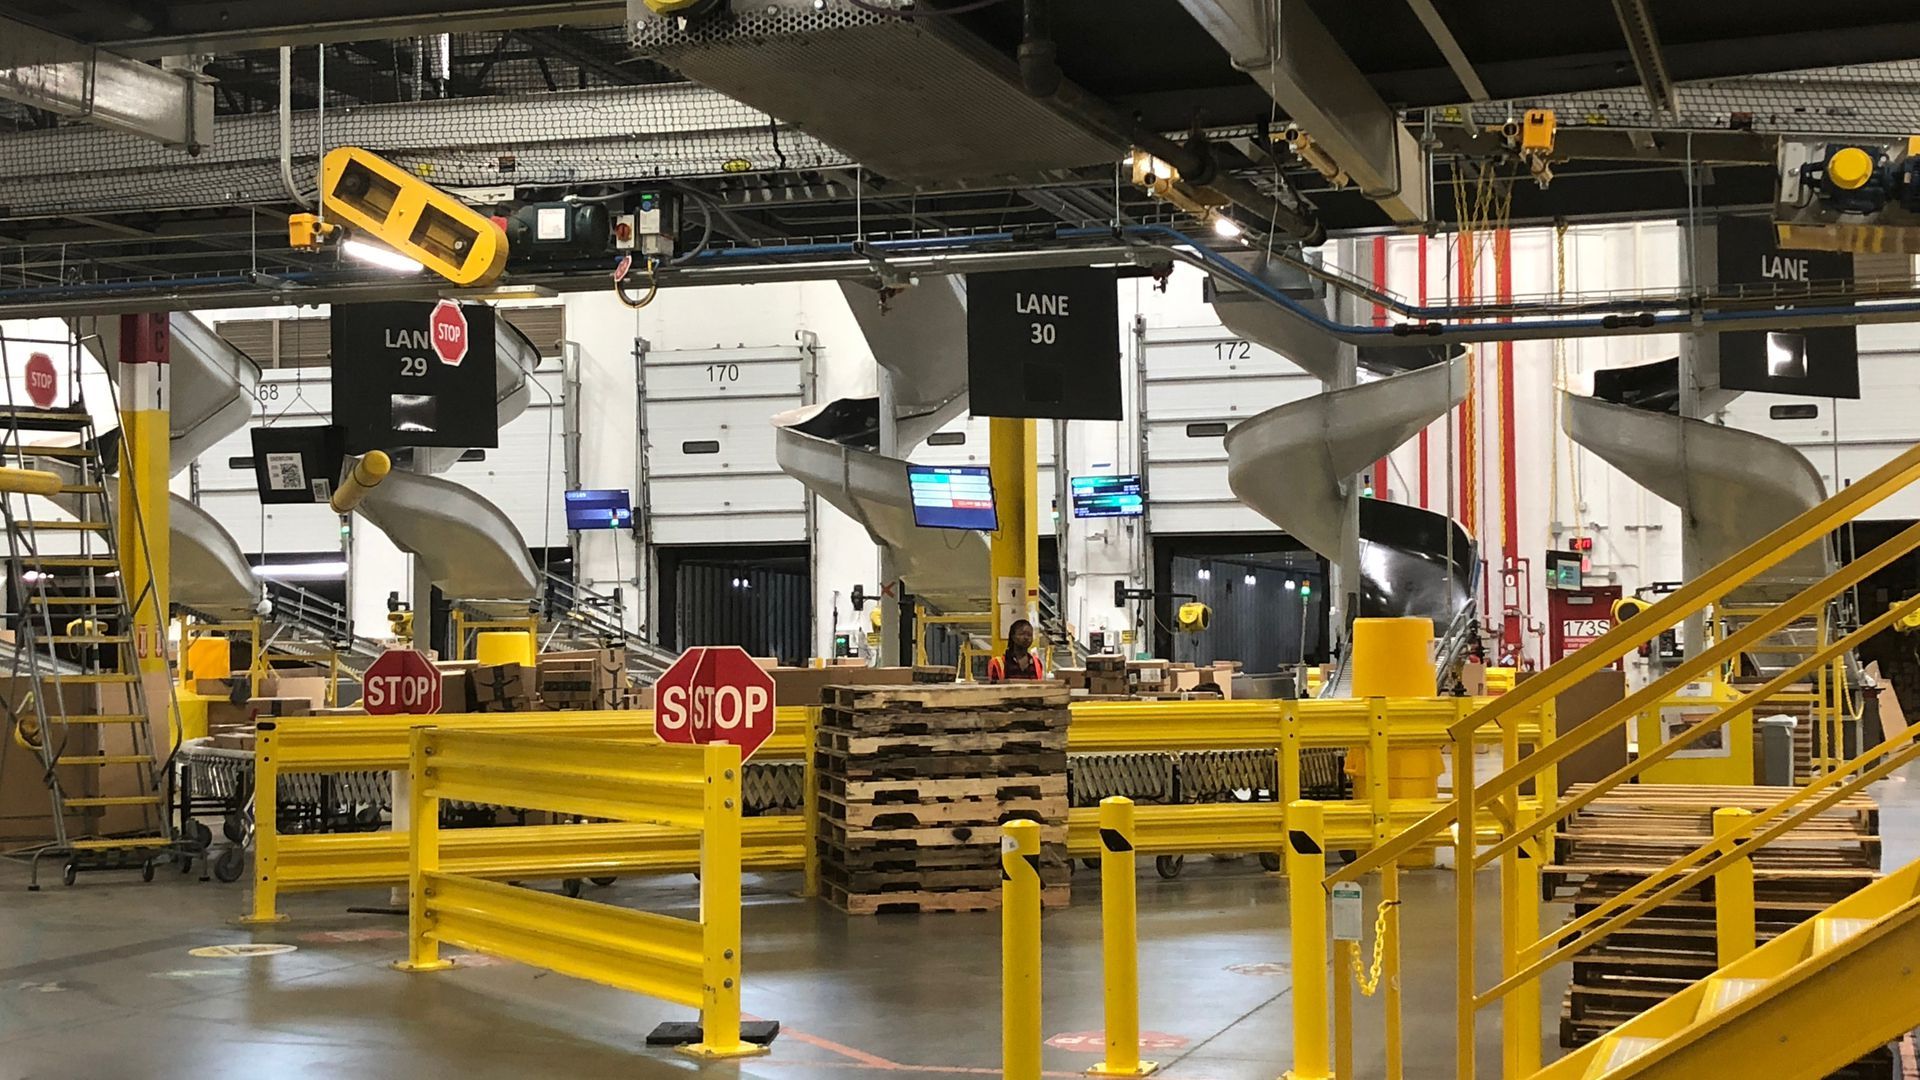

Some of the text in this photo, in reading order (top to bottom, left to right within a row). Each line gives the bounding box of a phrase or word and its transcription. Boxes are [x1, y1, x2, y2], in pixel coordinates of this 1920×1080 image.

[1761, 254, 1809, 281] LANE
[1016, 292, 1070, 317] LANE
[385, 328, 434, 351] LAN
[438, 322, 461, 344] STOP
[1030, 322, 1056, 345] 30
[1214, 340, 1251, 361] 172
[400, 356, 428, 377] 29
[706, 363, 739, 382] 170
[31, 371, 53, 389] STOP
[1564, 619, 1611, 637] 173S
[367, 675, 430, 706] STOP
[694, 684, 768, 730] STOP
